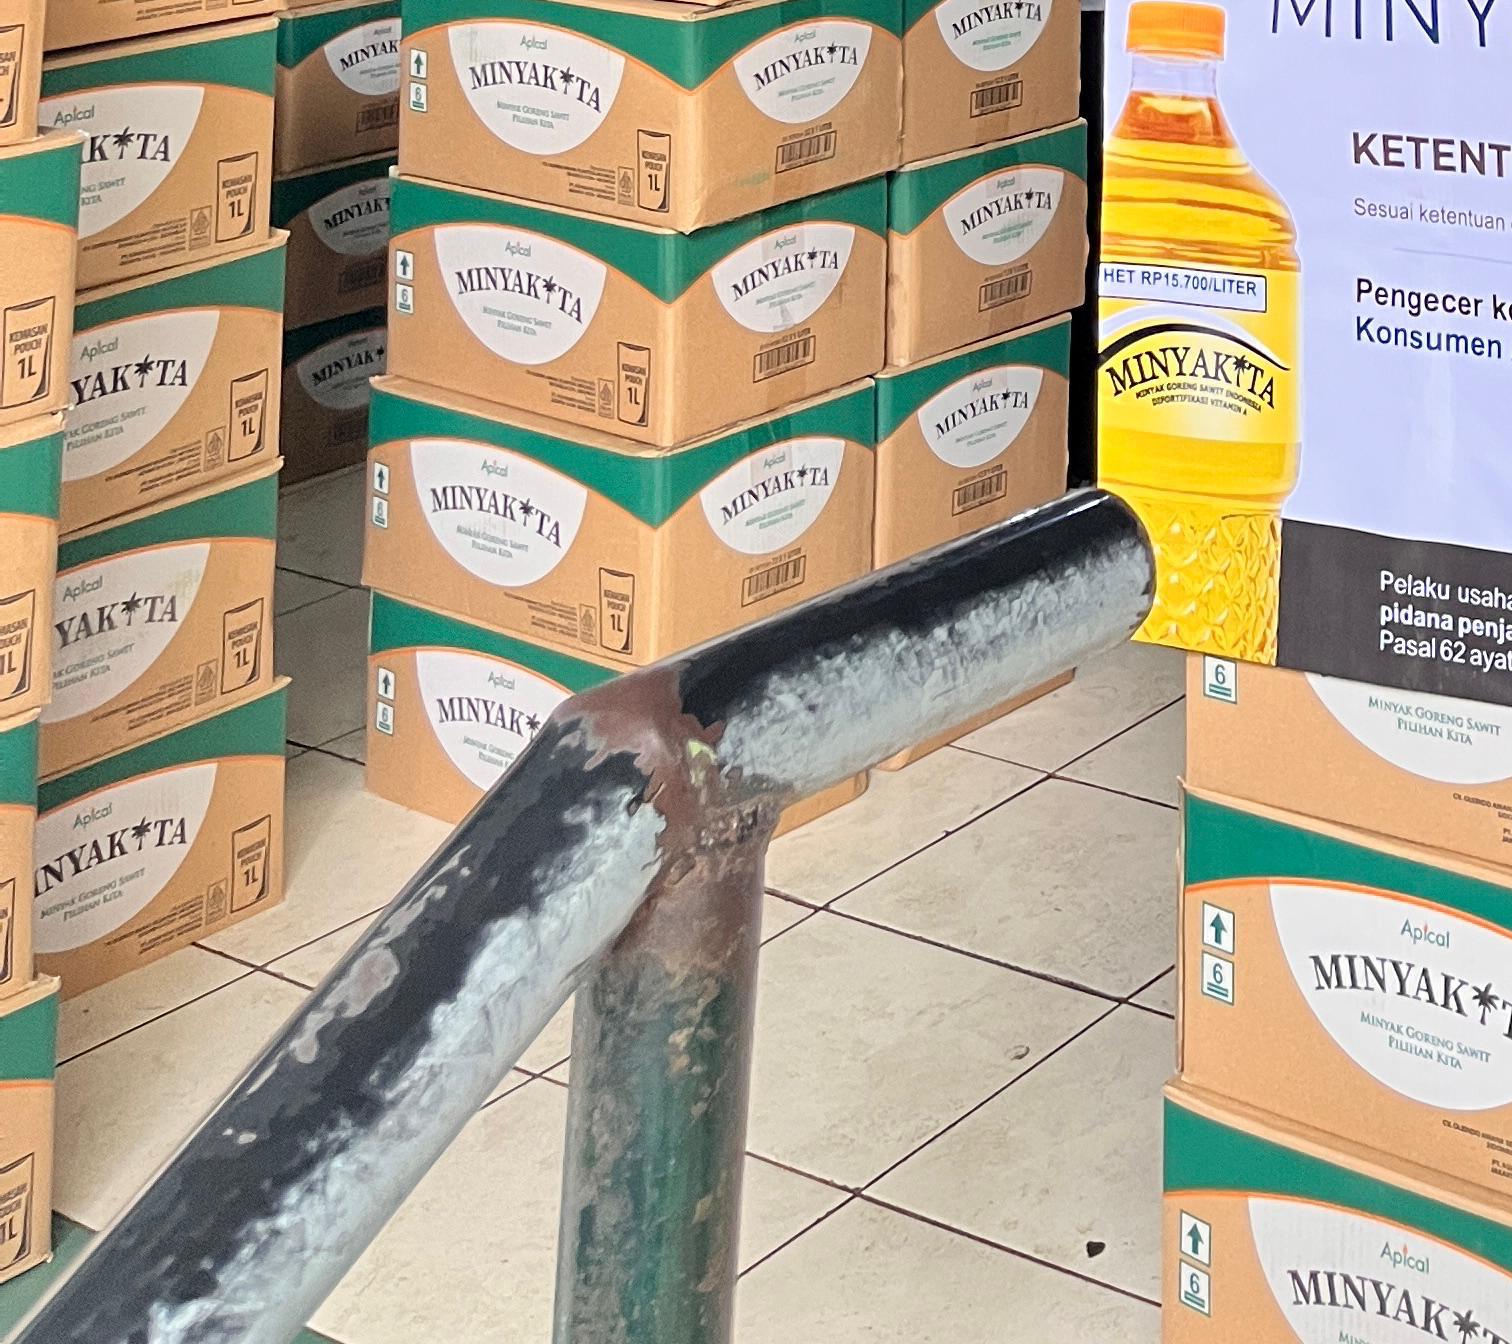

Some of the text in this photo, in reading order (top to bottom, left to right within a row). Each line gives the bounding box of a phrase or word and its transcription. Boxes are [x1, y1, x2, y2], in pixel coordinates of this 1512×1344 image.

[1353, 197, 1414, 221] Sesuai
[1418, 203, 1505, 232] ketentuan
[1104, 267, 1257, 297] HET RP15.700/LITER
[1356, 278, 1483, 318] Pengecer
[1356, 315, 1501, 360] Konsumen
[1380, 569, 1450, 601] Pelaku
[1379, 604, 1454, 631] pidana
[1400, 917, 1451, 950] Apical
